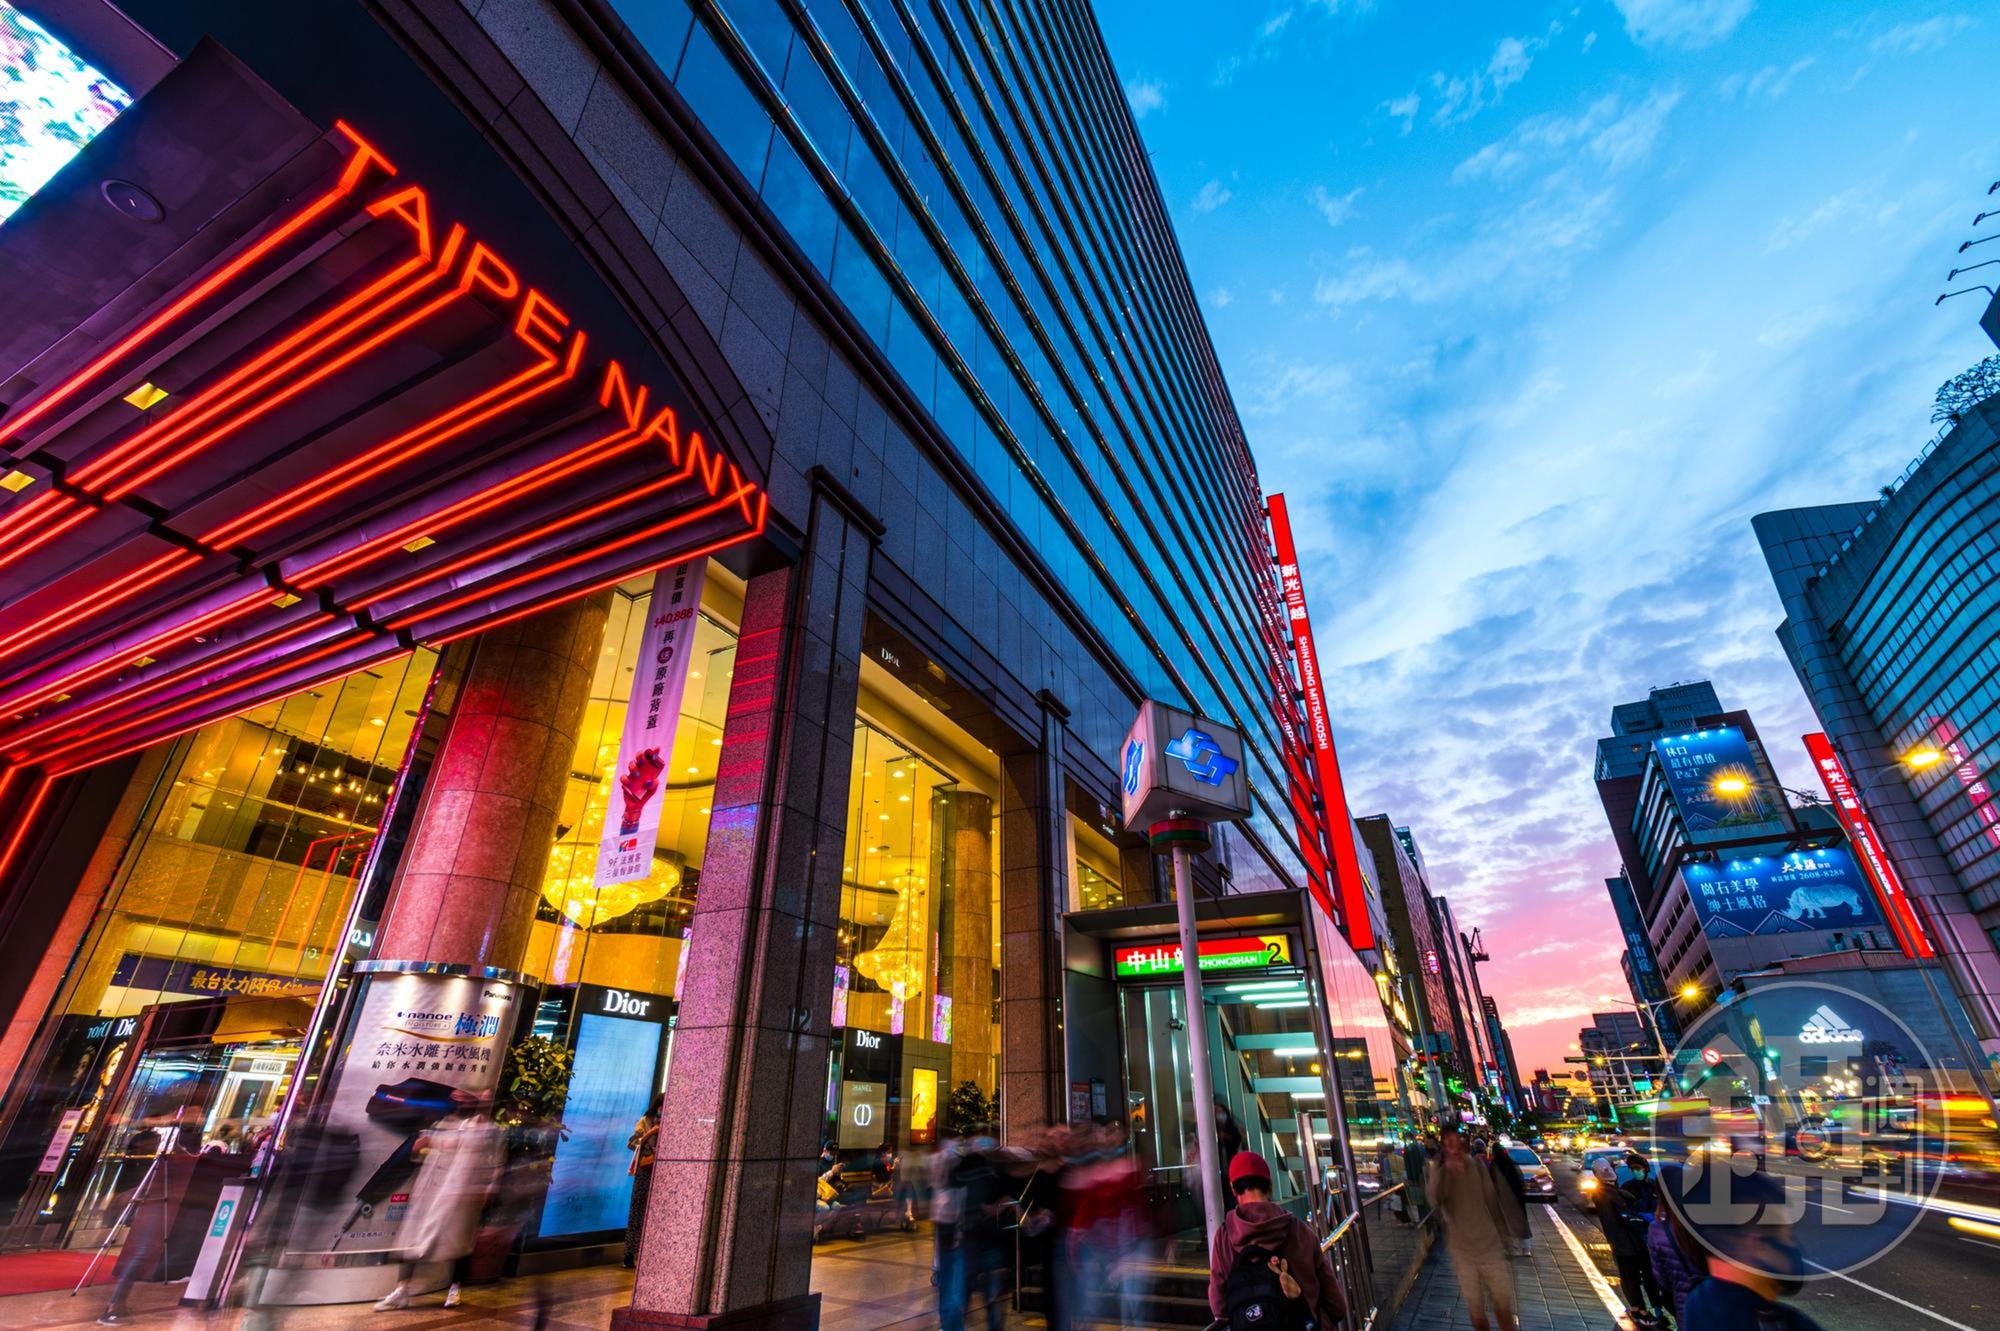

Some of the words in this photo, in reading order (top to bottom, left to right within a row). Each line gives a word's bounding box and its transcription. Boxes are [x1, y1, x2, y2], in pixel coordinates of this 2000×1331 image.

[336, 119, 587, 379] TAIPEI
[600, 360, 769, 535] NANXI
[1281, 564, 1307, 620] 新光三越
[1299, 635, 1310, 659] SHIN
[1302, 658, 1316, 687] KONG
[1308, 687, 1328, 750] MITSUKOSHI
[1666, 746, 1688, 757] 林口
[1670, 753, 1717, 769] 最有價值
[1675, 768, 1700, 779] P&T
[1199, 955, 1258, 968] ZHONGSHAN
[1266, 942, 1284, 965] 2
[603, 989, 650, 1016] Dior
[407, 1011, 453, 1021] nanoe
[455, 1012, 500, 1038] 極潤
[856, 1030, 881, 1049] Dior
[1799, 1027, 1864, 1043] adidas
[376, 1041, 492, 1062] 奈米水離子吹風機
[391, 1194, 408, 1202] NEW
